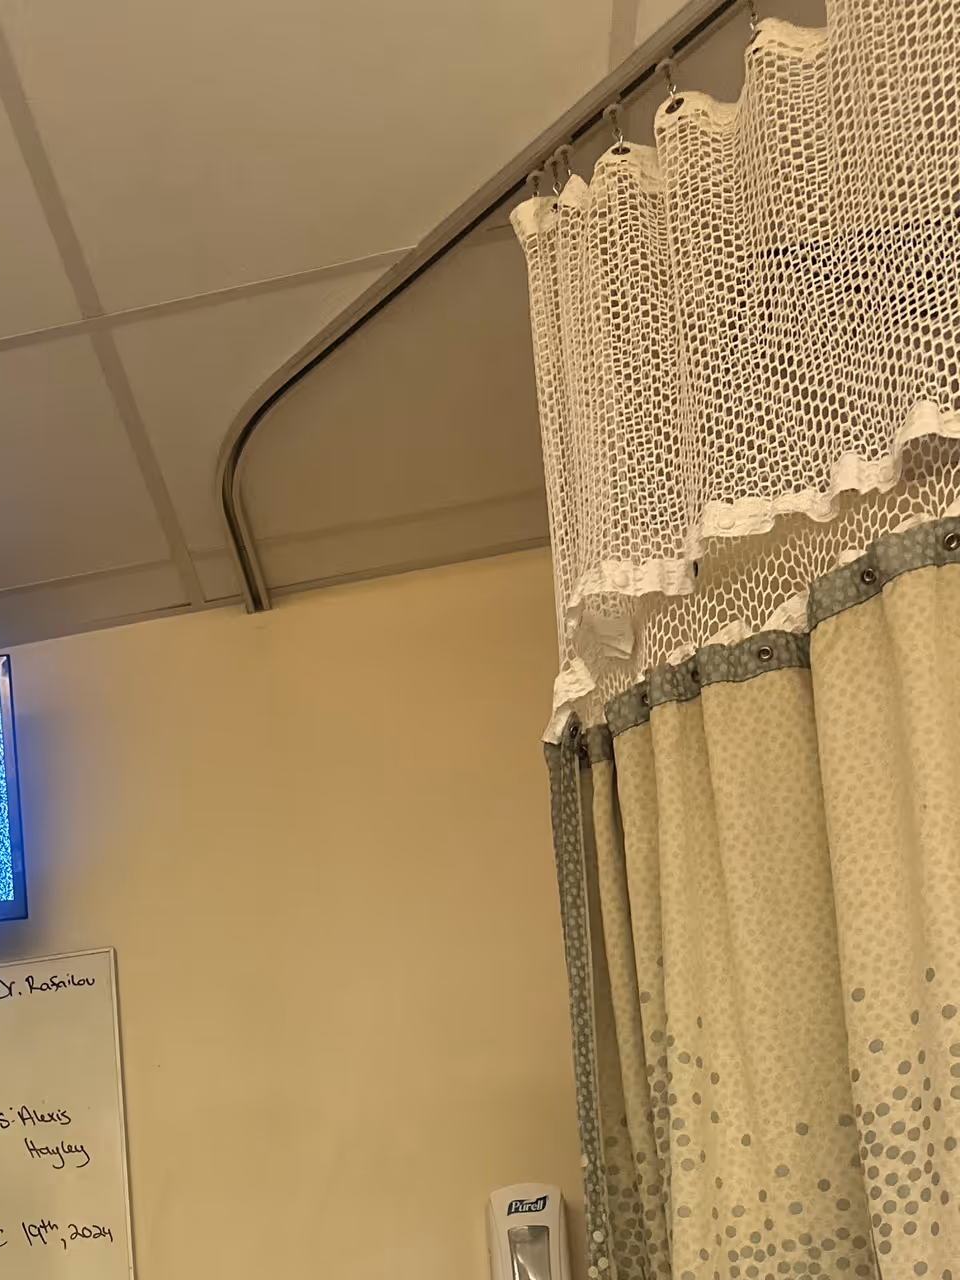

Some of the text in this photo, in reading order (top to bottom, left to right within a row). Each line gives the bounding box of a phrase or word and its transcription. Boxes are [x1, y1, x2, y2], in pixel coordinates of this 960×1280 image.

[17, 1105, 72, 1126] Alexis
[24, 1138, 90, 1169] Hayley
[512, 1200, 544, 1212] Purell
[68, 1224, 113, 1242] 2024
